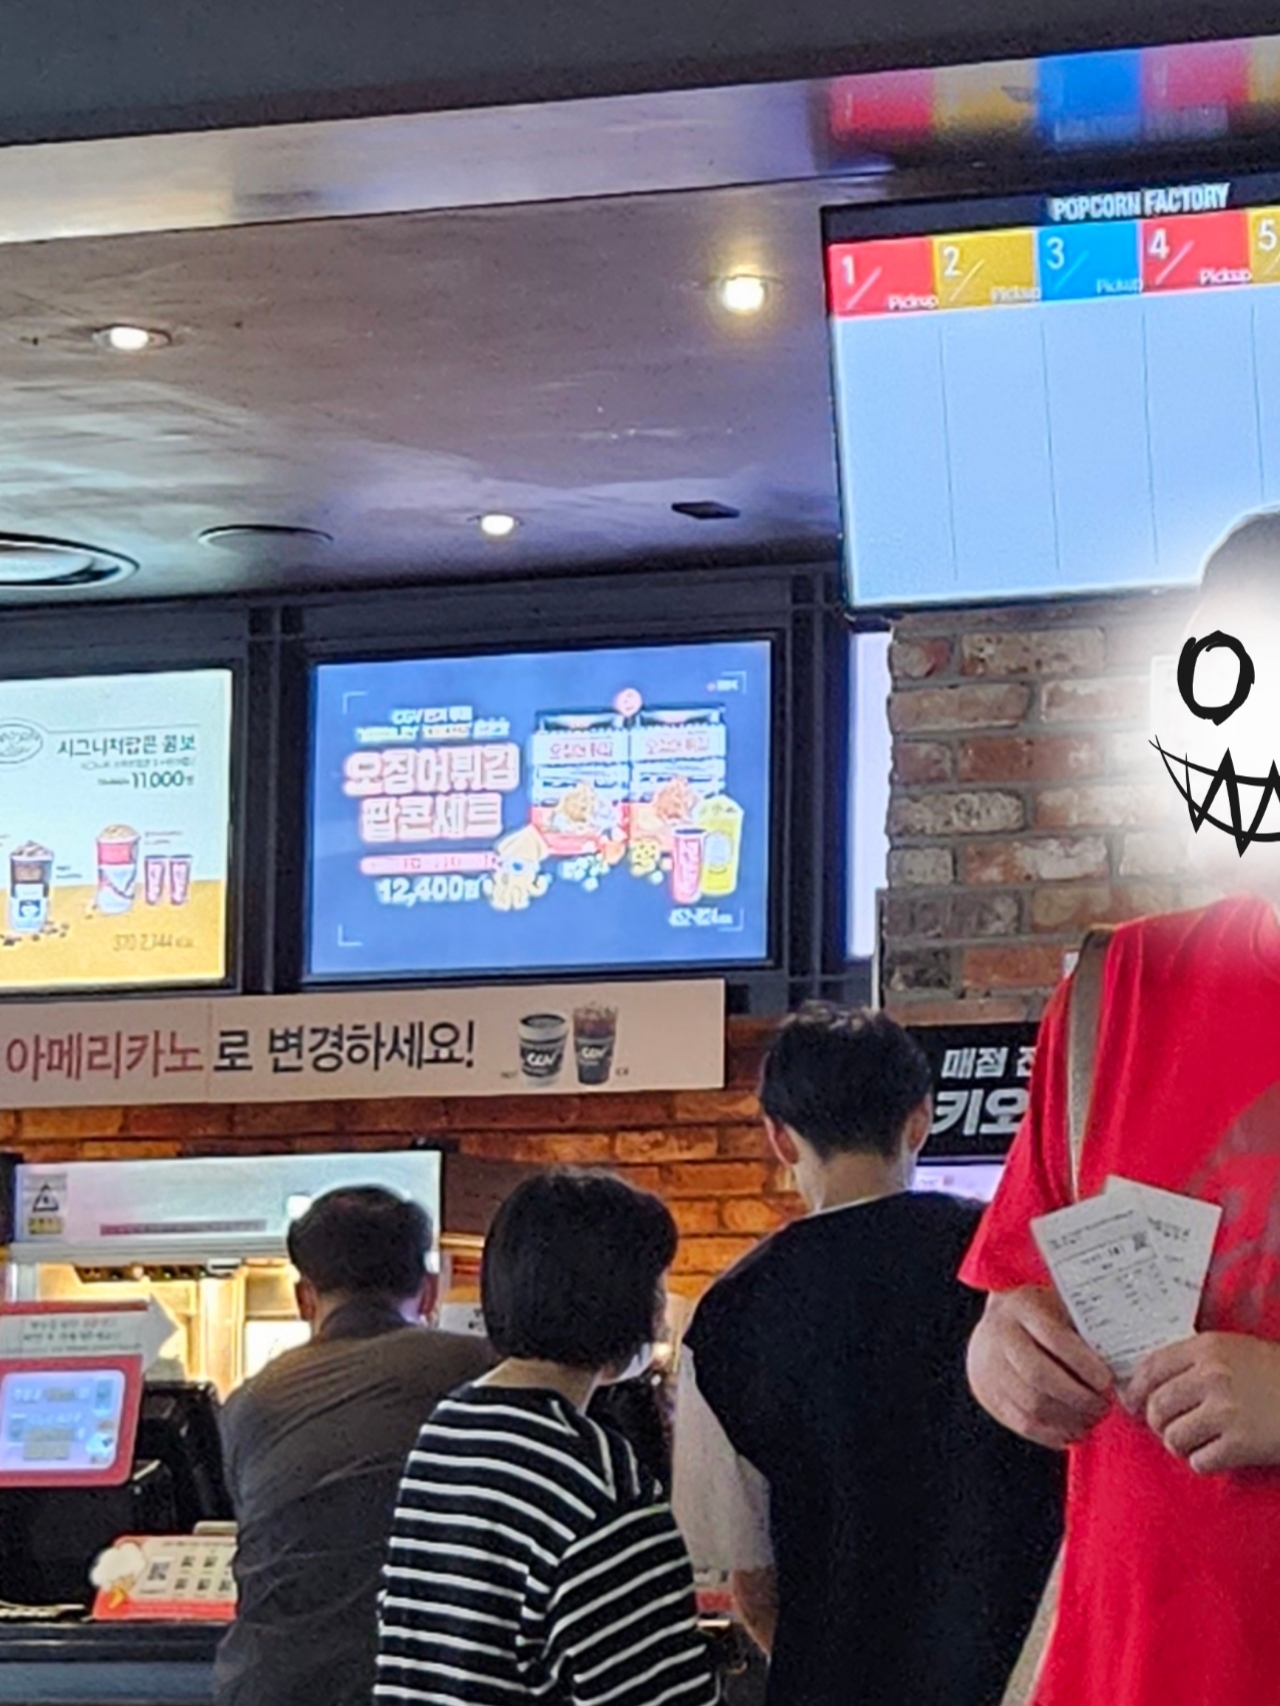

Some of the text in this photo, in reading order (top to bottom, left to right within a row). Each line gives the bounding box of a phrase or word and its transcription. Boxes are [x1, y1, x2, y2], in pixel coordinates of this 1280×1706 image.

[1051, 181, 1231, 222] POPCORN FACTORY
[1149, 228, 1169, 260] 4
[1257, 218, 1279, 251] 5
[942, 246, 962, 278] 2
[1045, 236, 1065, 270] 3
[842, 254, 856, 285] 1
[1199, 267, 1252, 286] Pickup
[888, 294, 938, 312] Pickup
[990, 286, 1042, 303] Pickup
[1096, 279, 1143, 295] Pickup
[267, 1019, 476, 1074] 변경하세요!
[940, 1046, 1009, 1080] 매점
[929, 1087, 1031, 1137] 키오
